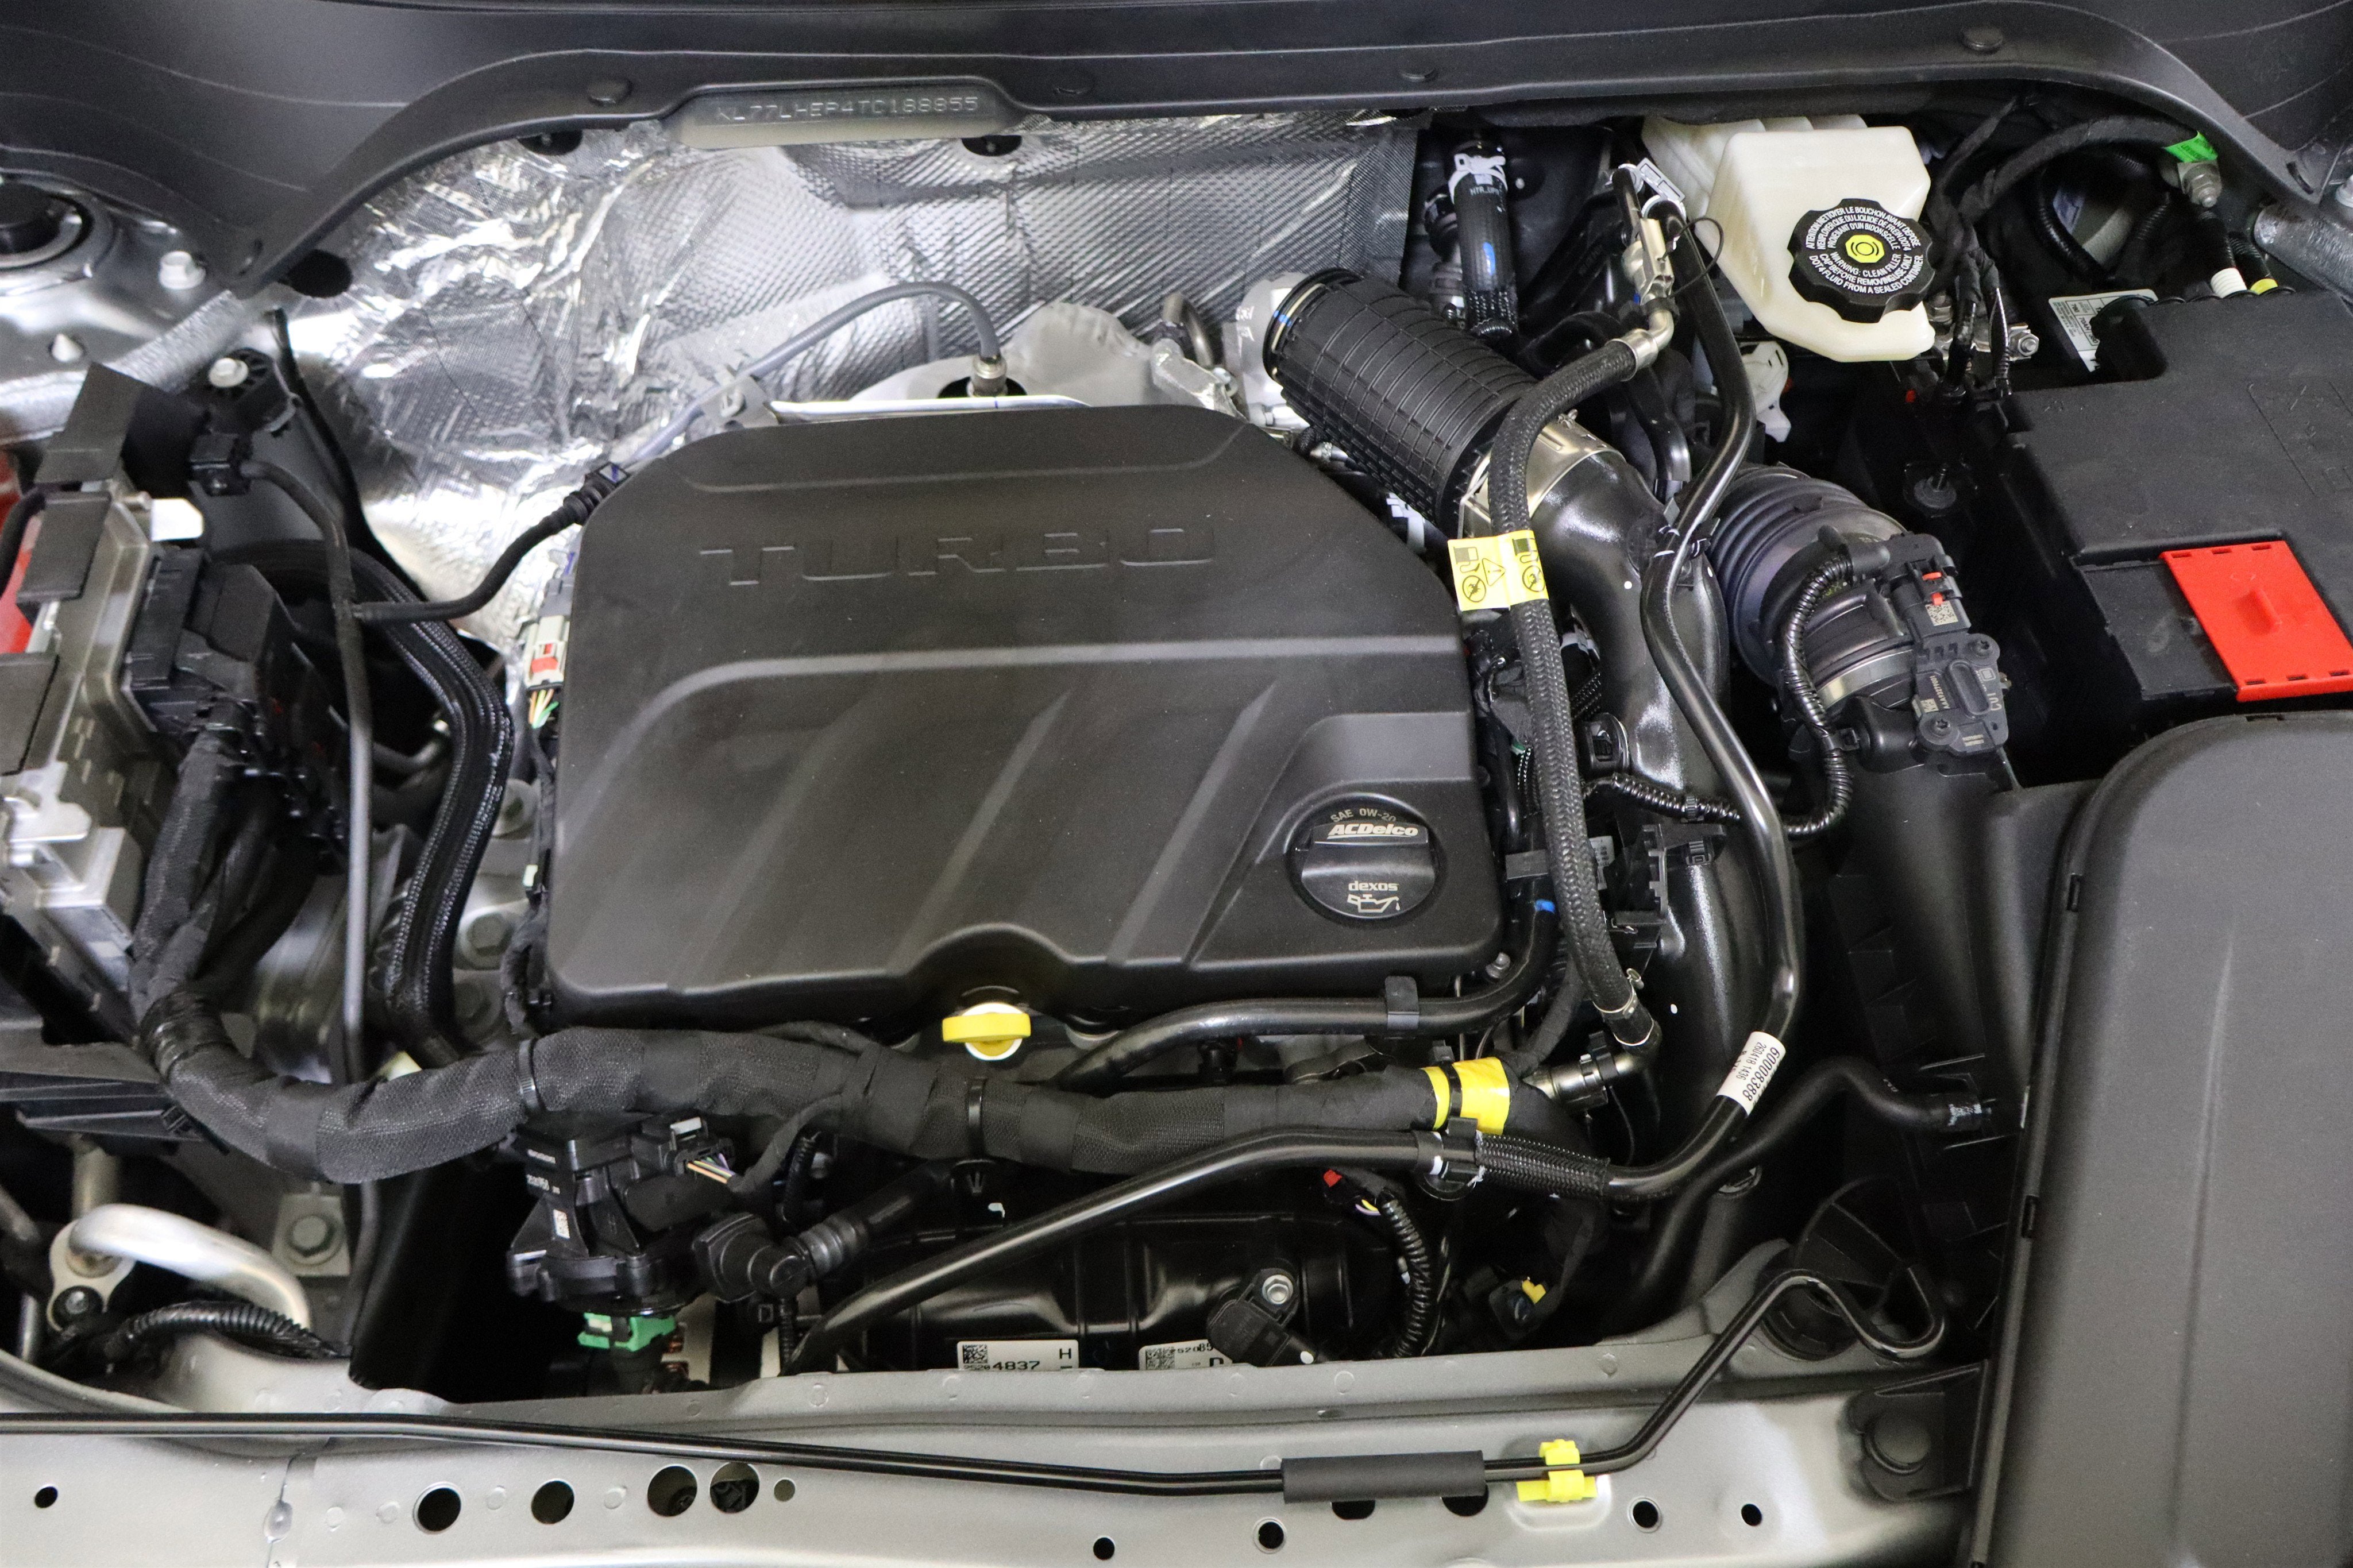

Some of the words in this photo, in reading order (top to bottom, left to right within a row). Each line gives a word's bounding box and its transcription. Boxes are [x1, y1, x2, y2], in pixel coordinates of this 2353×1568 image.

[1854, 215, 1879, 224] LIQUIDE
[1877, 219, 1888, 227] DE
[1885, 224, 1904, 238] FREIN
[1855, 207, 1886, 218] BOUCHON
[1884, 215, 1906, 229] AVANT
[1865, 223, 1884, 234] BIDON
[1819, 253, 1833, 265] CAP
[1829, 264, 1857, 283] BEFORE
[1900, 254, 1912, 269] ONLY
[1830, 252, 1861, 276] WARNING:
[1862, 268, 1888, 277] CLEAN
[1885, 253, 1901, 272] FILLER
[1822, 269, 1843, 285] FLUID
[1843, 281, 1866, 293] FROM
[1874, 281, 1903, 293] SEALED
[699, 528, 1214, 586] TURBO
[1330, 809, 1353, 822] SAE
[1359, 808, 1397, 822] 0W-20
[1328, 824, 1418, 837] ACDelco
[1348, 880, 1399, 891] dexos
[1736, 1066, 1752, 1080] 1436
[1742, 1047, 1780, 1102] 60008388
[1059, 1348, 1071, 1359] H
